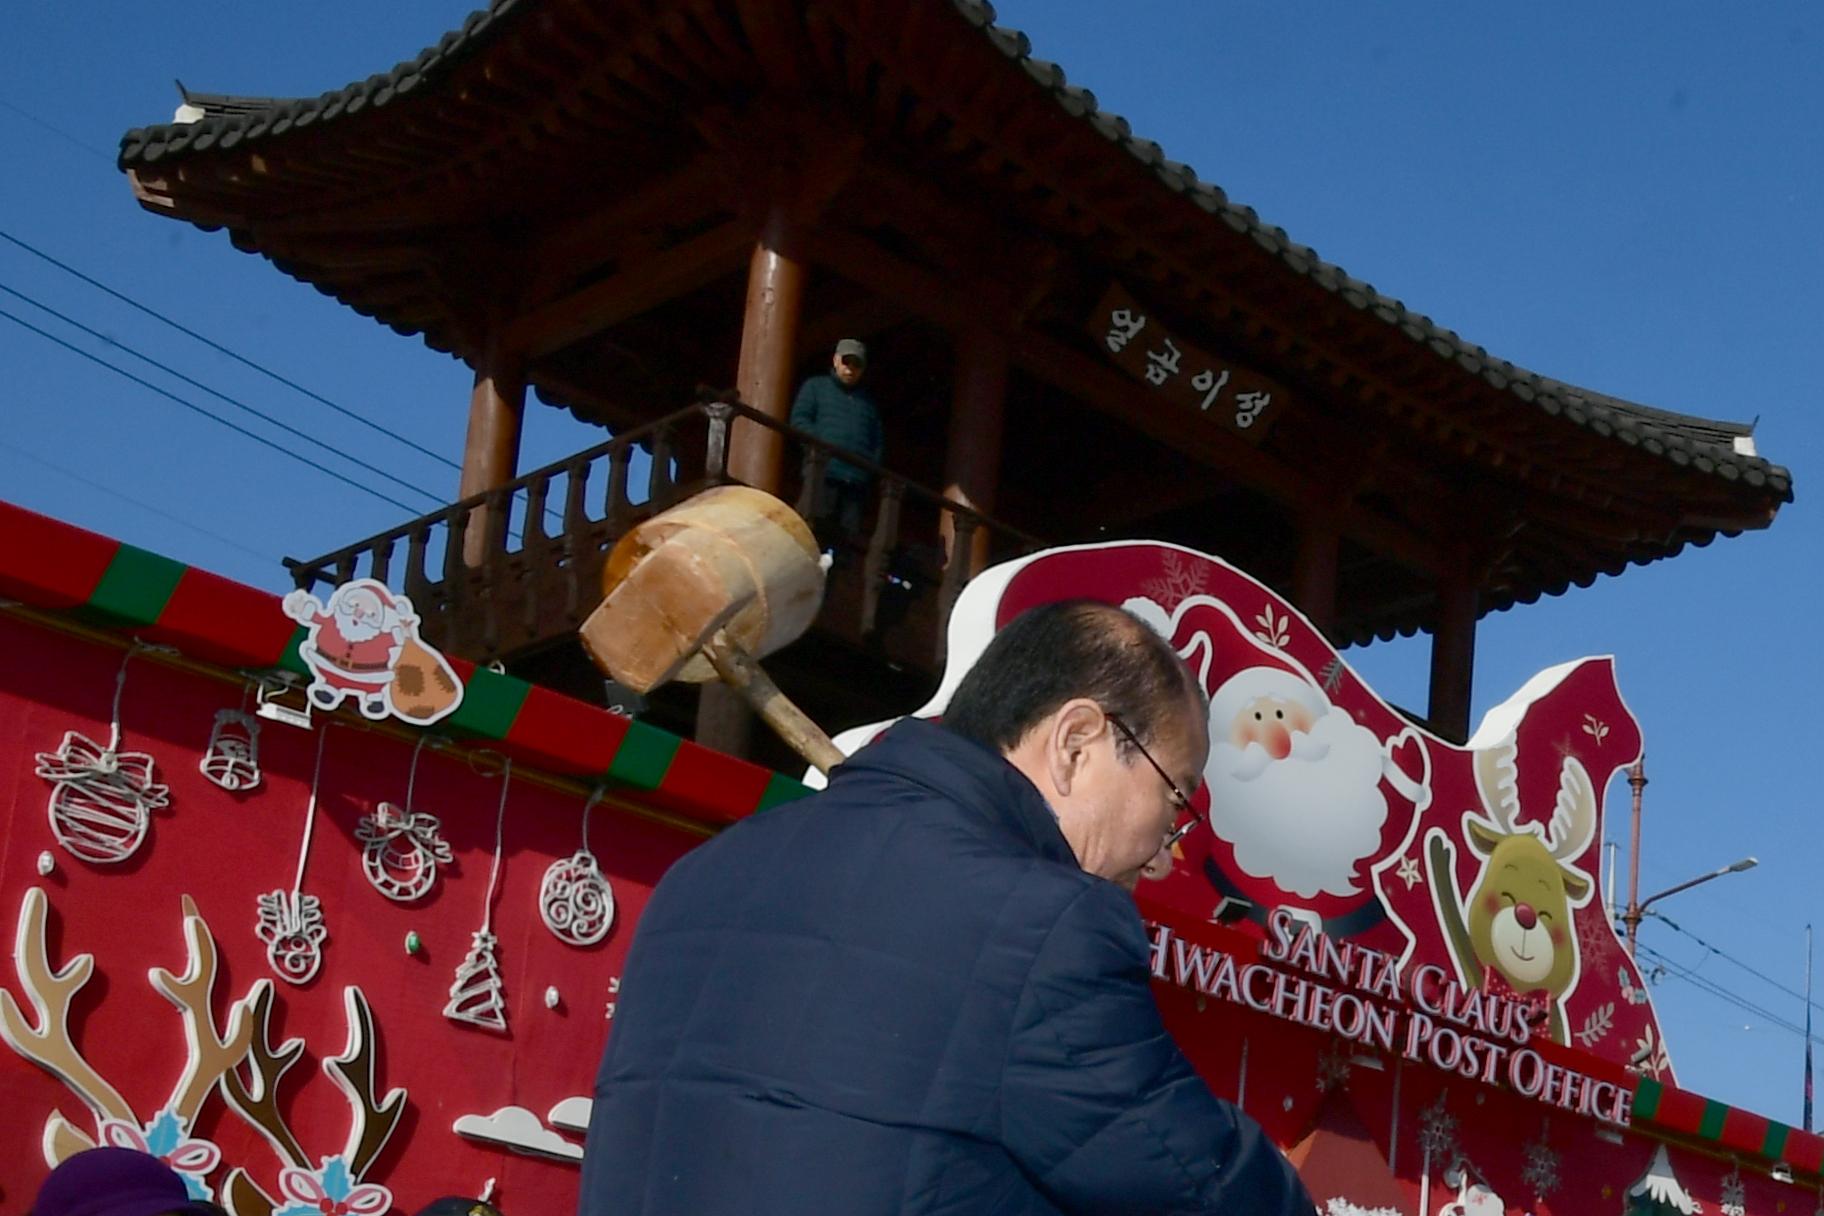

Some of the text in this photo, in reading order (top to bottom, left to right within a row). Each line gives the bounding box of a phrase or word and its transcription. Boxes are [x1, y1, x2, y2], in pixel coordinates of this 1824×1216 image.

[1264, 908, 1532, 1045] SANTA CLAUS
[1402, 1009, 1507, 1085] POST
[1509, 1048, 1633, 1127] OFFICE
